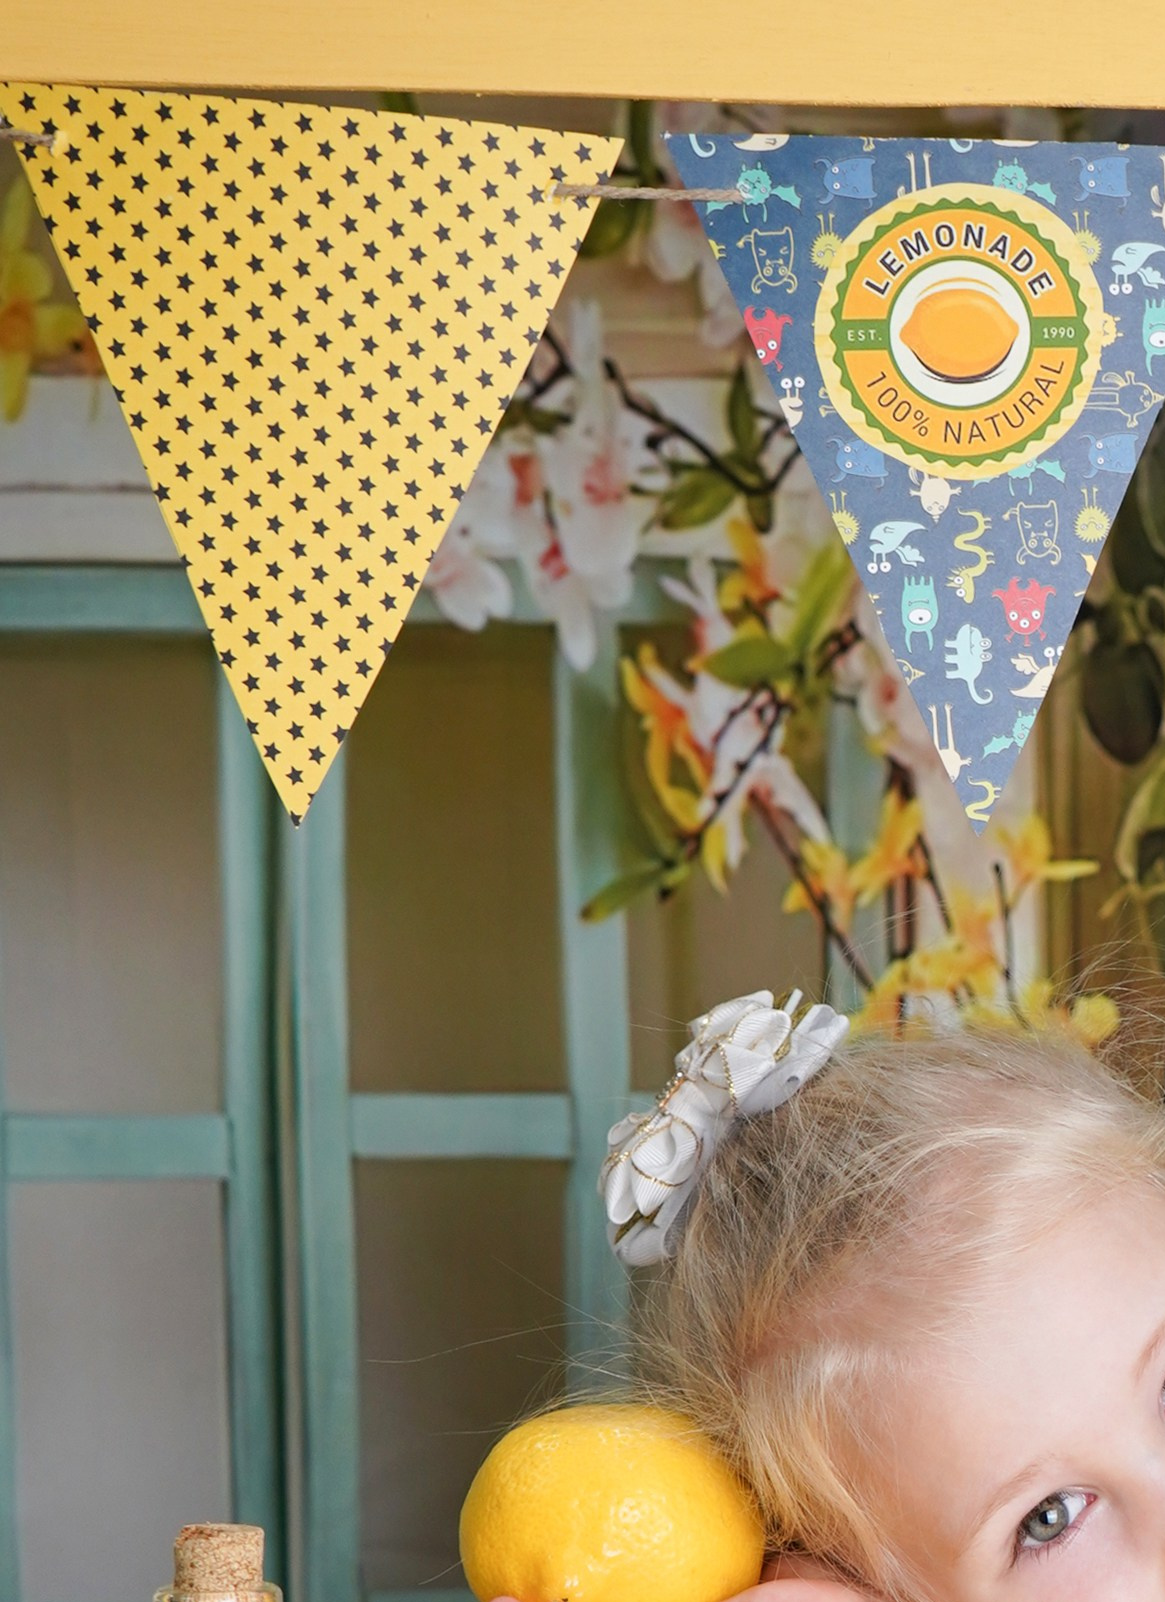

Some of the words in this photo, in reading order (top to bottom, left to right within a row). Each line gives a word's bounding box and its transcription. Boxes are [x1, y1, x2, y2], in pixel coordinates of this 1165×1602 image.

[863, 223, 1054, 297] LEMONADE
[847, 328, 883, 342] EST.
[1042, 326, 1075, 339] 1990
[865, 371, 929, 438] 100%
[943, 360, 1065, 445] NATURAL
